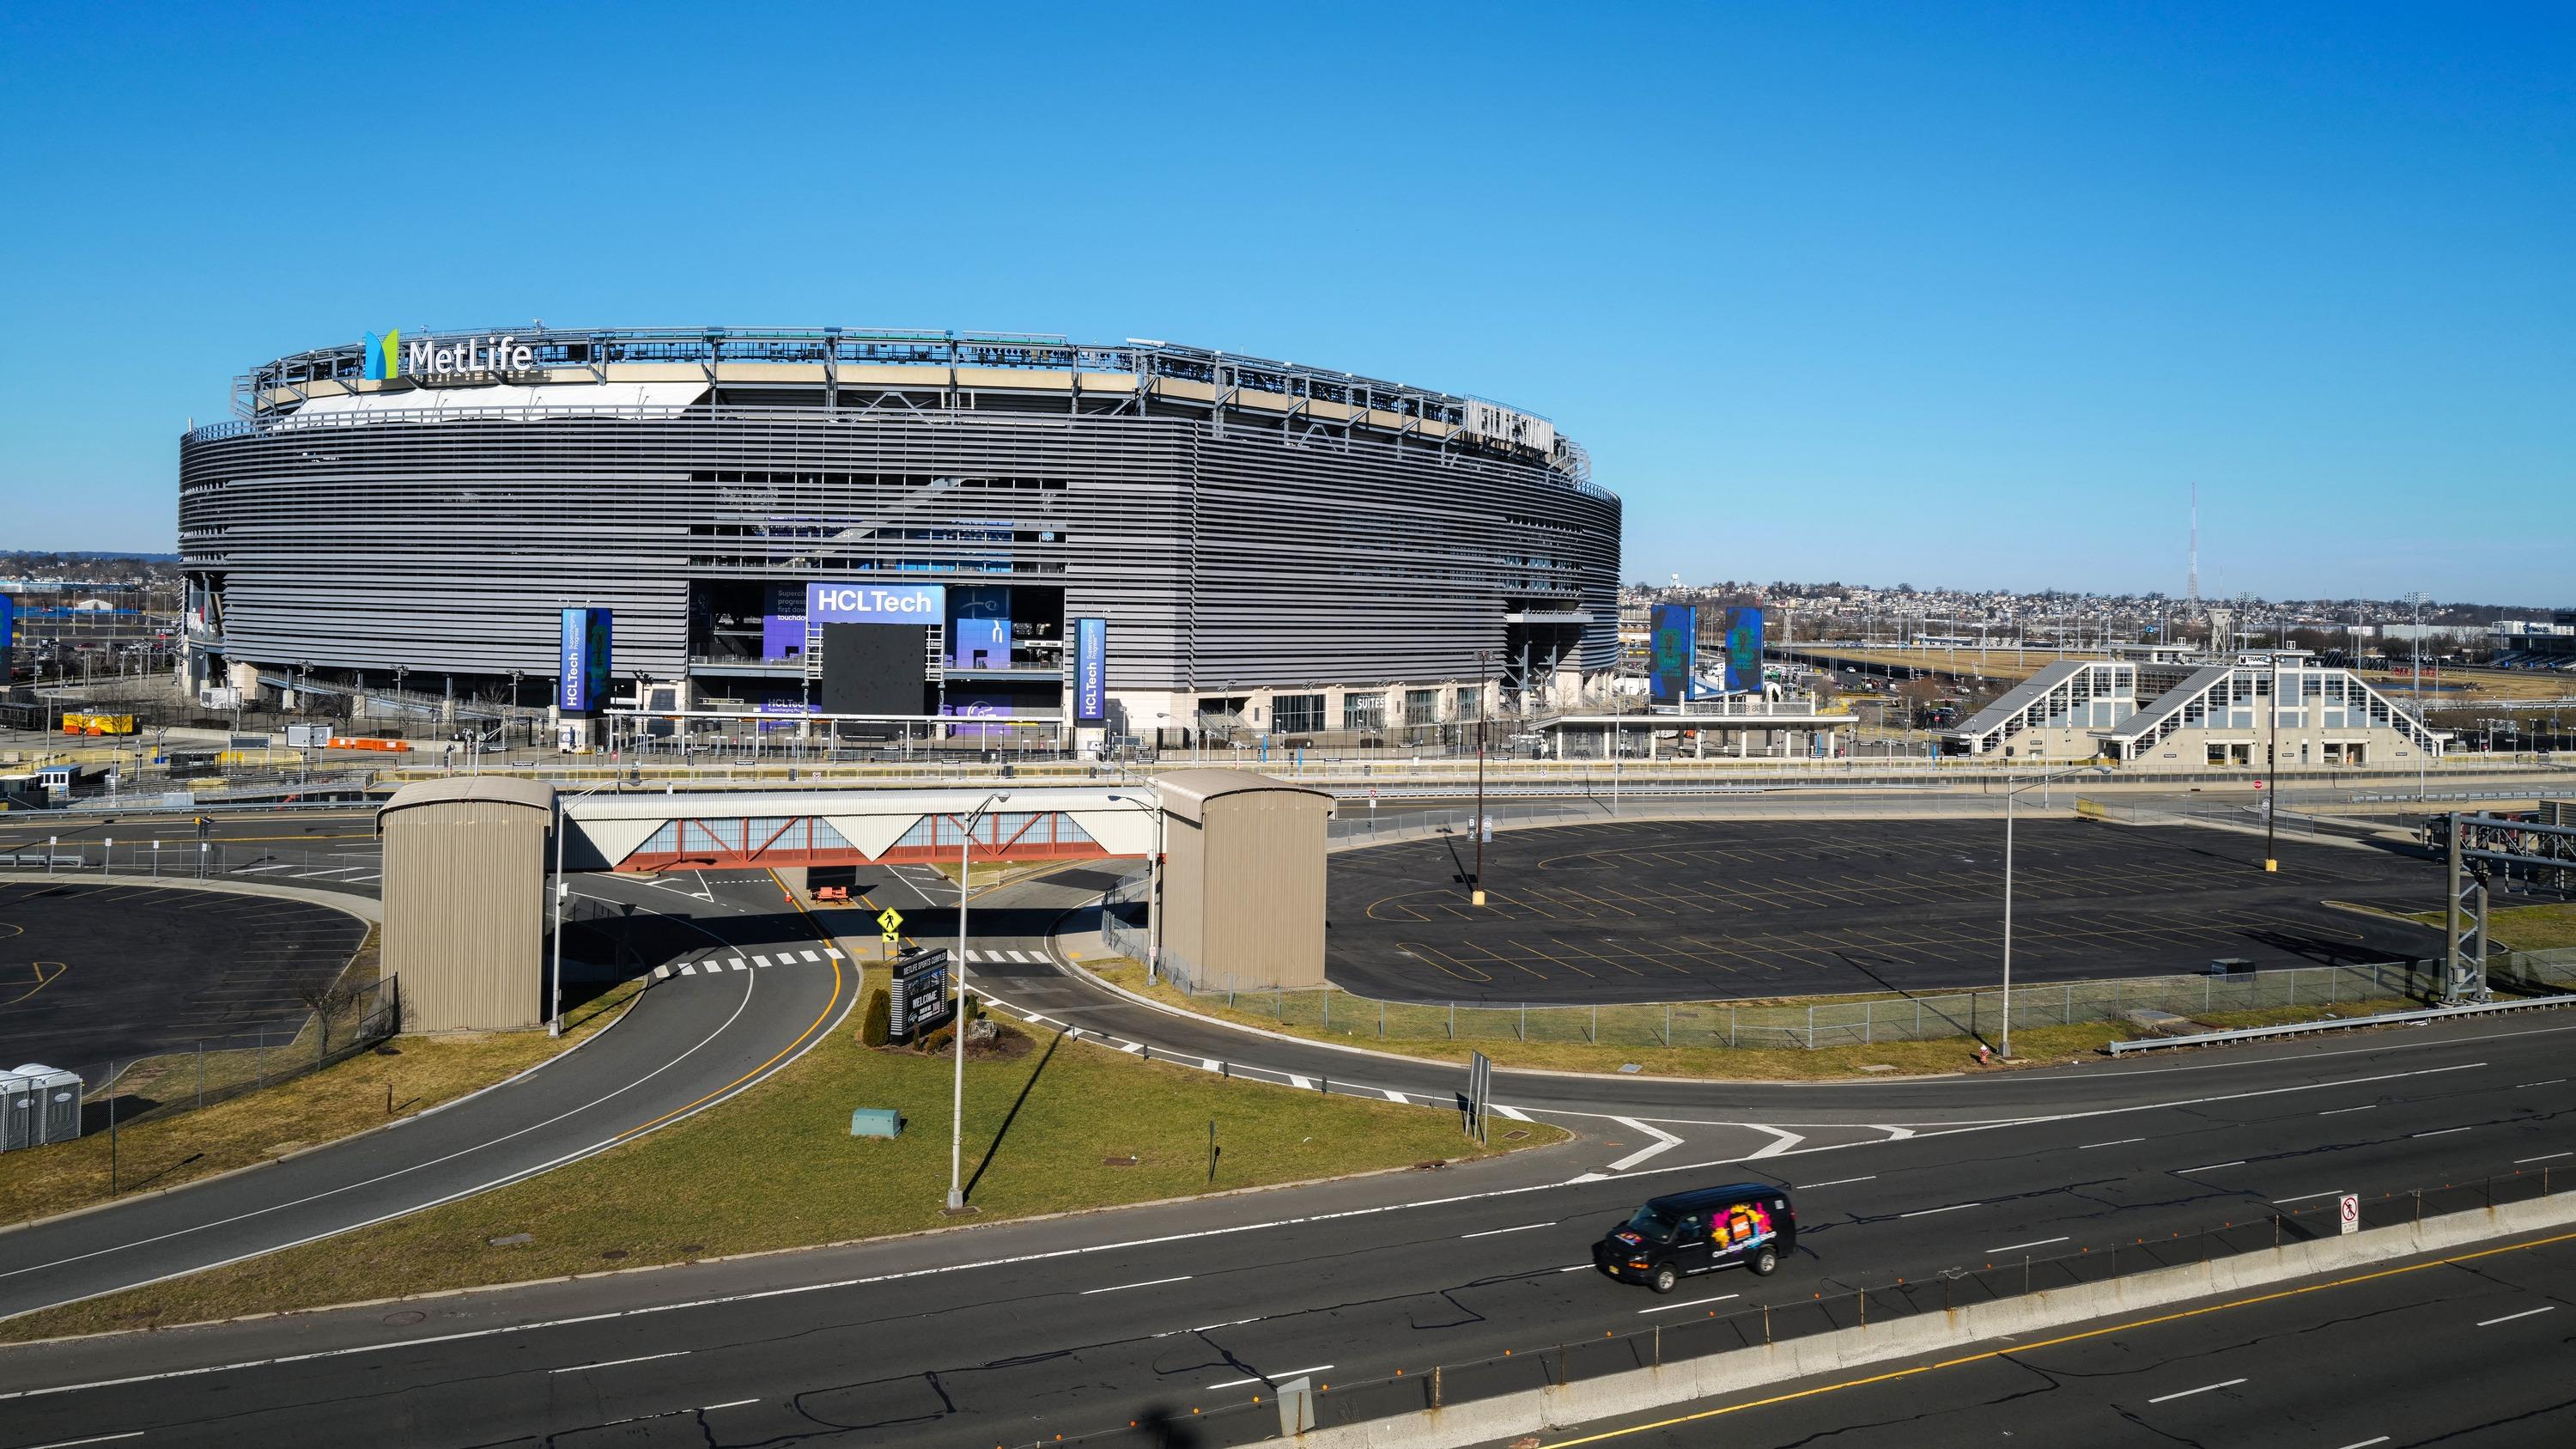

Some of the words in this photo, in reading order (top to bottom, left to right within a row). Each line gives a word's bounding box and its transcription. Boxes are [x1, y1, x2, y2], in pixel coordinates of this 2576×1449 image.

[409, 336, 532, 374] MetLife
[818, 589, 932, 612] HCLTech
[567, 653, 579, 706] HCLTech
[1085, 662, 1097, 715] HCLTech
[769, 698, 804, 708] HCLTec
[1358, 697, 1384, 709] SUITES
[903, 963, 917, 976] METLIFE
[918, 958, 931, 970] SPORTS
[931, 952, 946, 965] COMPLEX
[913, 990, 938, 1009] WELCOME
